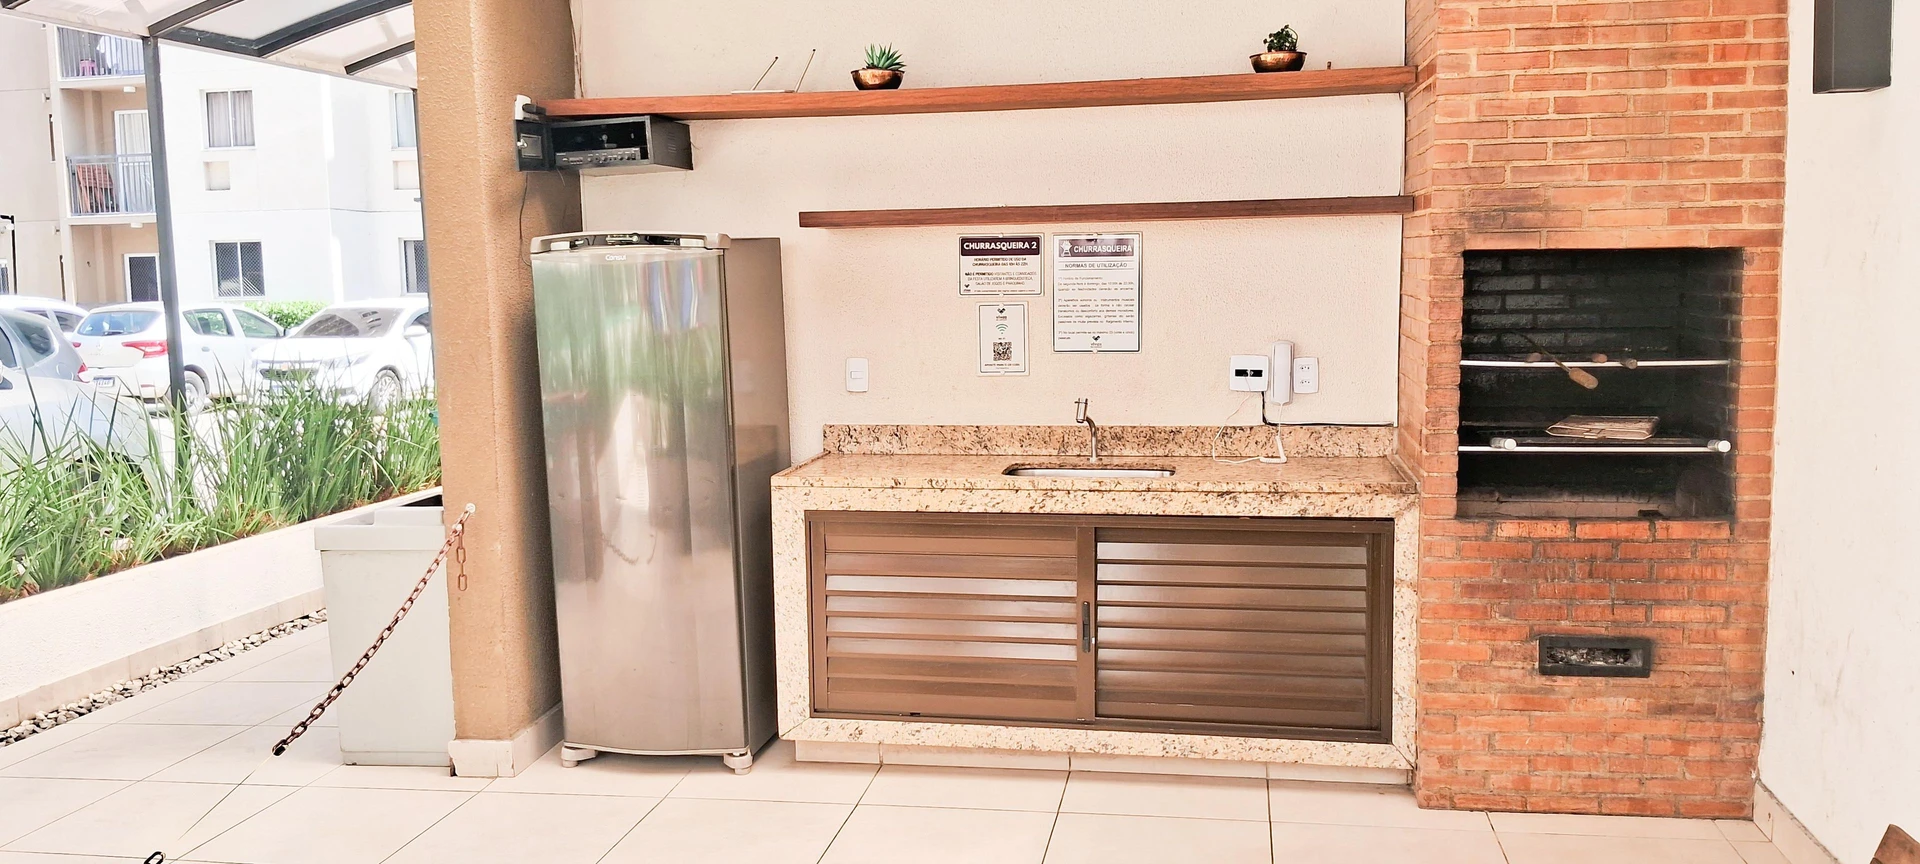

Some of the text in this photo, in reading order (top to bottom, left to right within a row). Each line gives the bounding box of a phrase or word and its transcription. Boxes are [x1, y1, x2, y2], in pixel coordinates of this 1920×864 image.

[963, 241, 1037, 250] CHURRASQUEIRA 2
[1073, 244, 1132, 253] CHURRASQUEIRA
